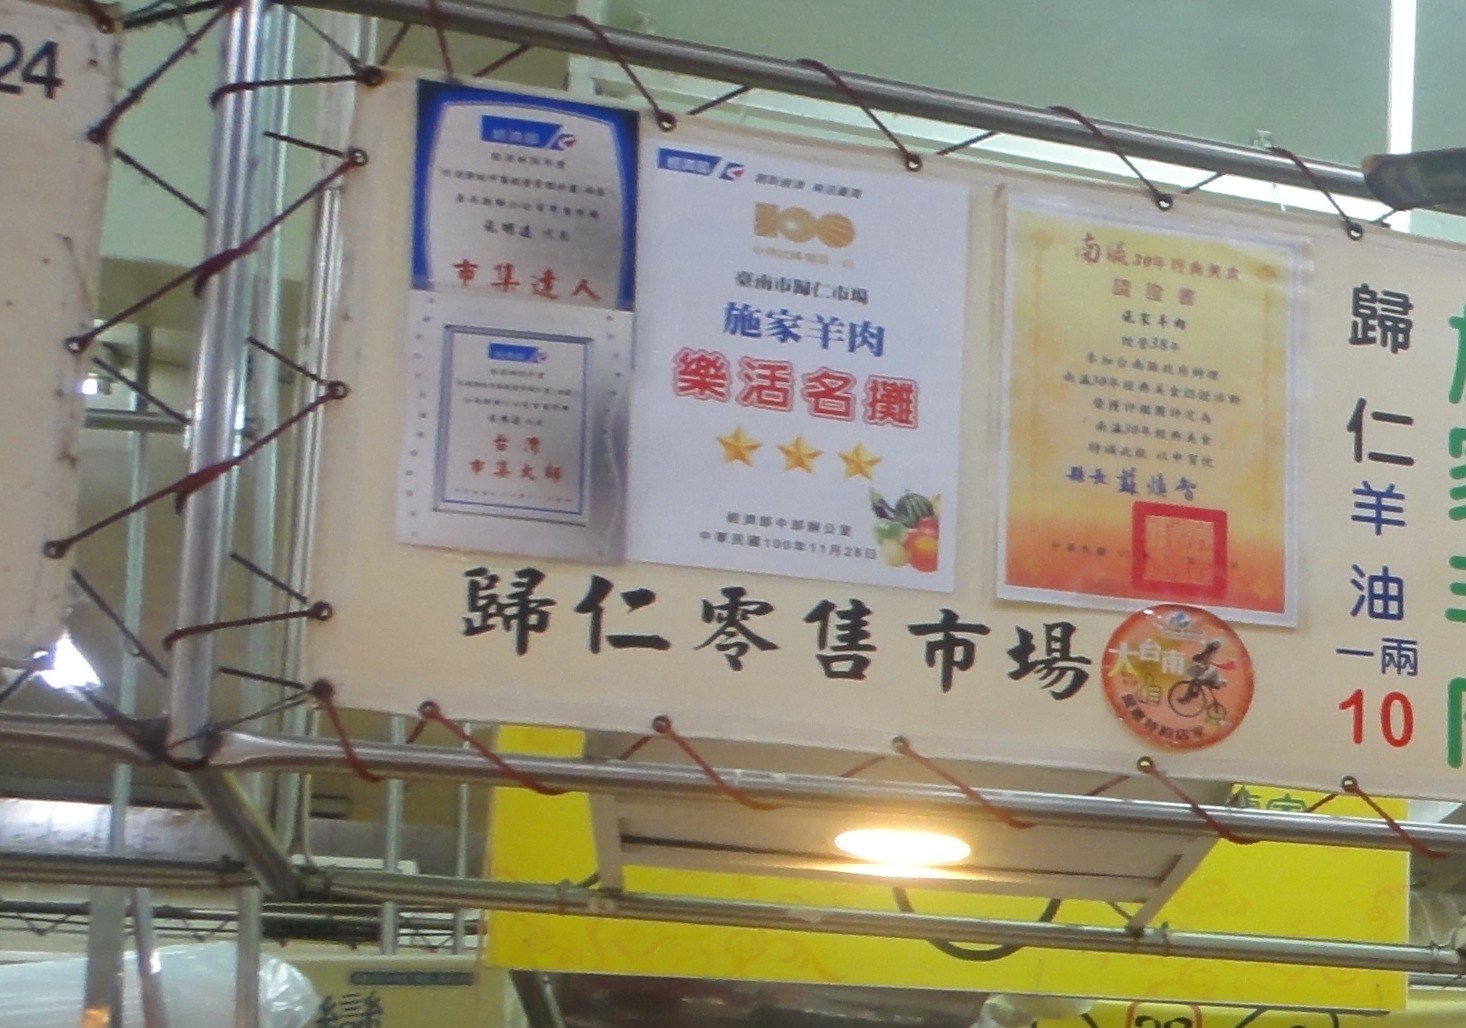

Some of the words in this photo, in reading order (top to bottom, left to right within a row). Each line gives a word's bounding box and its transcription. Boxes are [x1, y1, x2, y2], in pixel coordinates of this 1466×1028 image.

[453, 259, 601, 300] 市集達人
[722, 302, 885, 358] 施家羊肉
[672, 347, 919, 430] 樂活名攤
[1346, 283, 1415, 467] 歸仁
[1350, 481, 1407, 622] 羊油
[462, 567, 1092, 701] 歸仁零售市場
[1336, 638, 1419, 677] 一兩
[1339, 689, 1414, 748] 10
